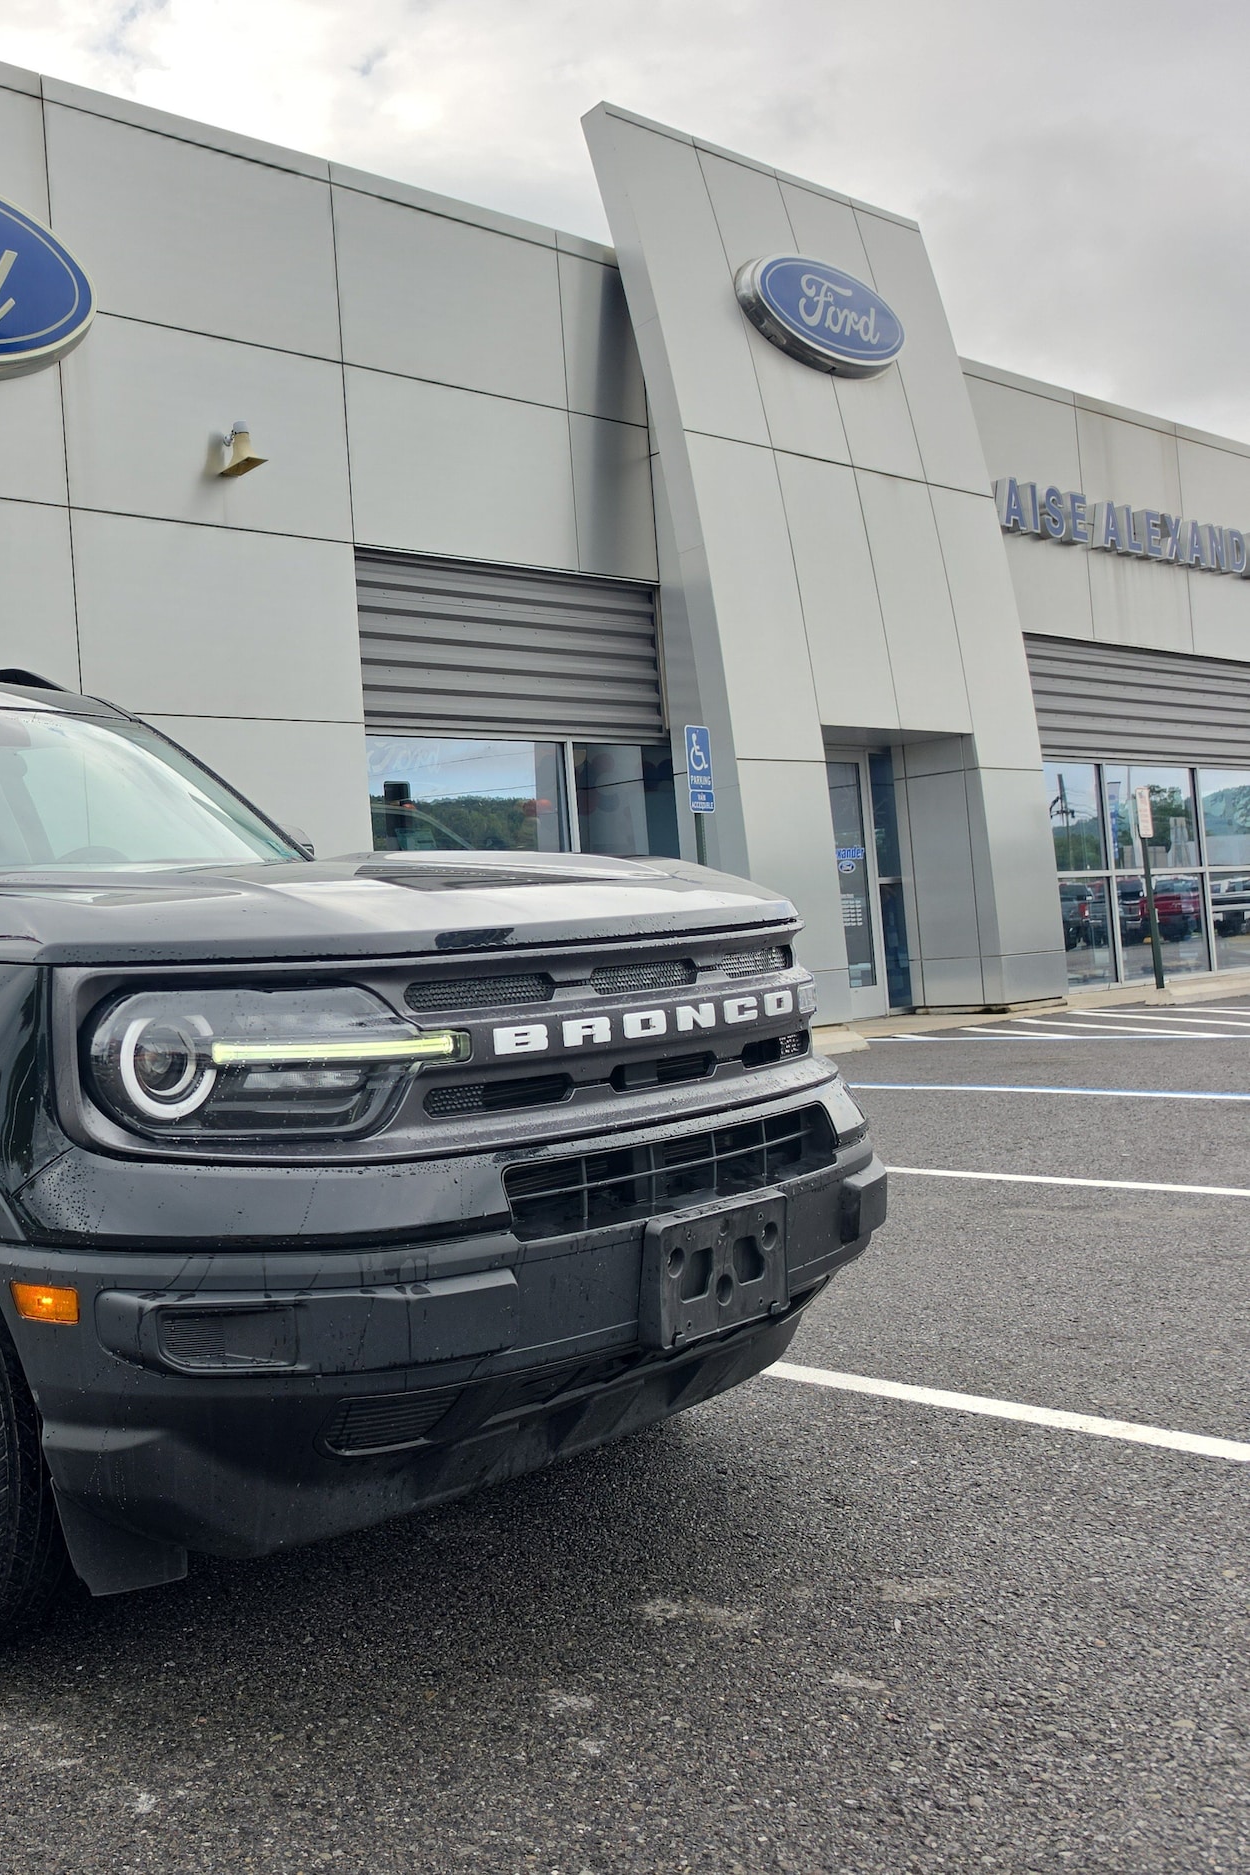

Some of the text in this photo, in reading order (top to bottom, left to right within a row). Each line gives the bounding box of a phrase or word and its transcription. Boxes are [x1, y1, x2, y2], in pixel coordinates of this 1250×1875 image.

[799, 274, 880, 345] Ford
[996, 477, 1250, 574] AISE ALEXAND
[690, 775, 711, 785] PARKING
[492, 990, 793, 1055] BRONCO
